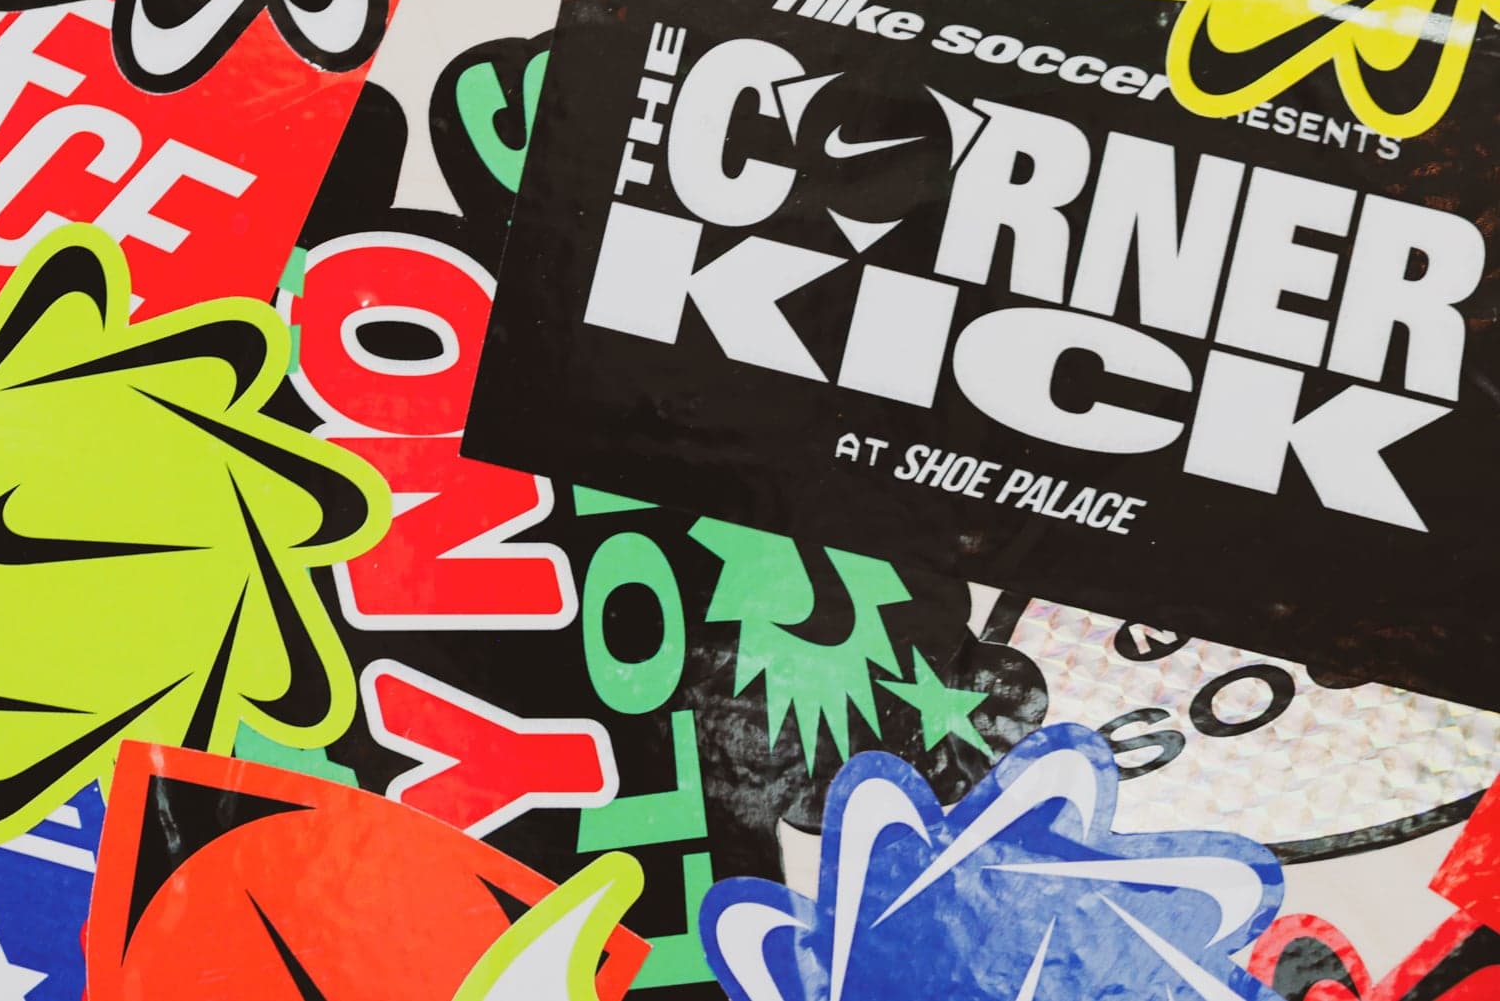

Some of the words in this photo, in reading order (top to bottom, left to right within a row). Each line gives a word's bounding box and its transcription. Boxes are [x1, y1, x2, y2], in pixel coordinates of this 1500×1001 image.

[613, 22, 688, 195] THE
[931, 23, 1174, 102] soccer
[1222, 102, 1403, 160] ESENTS
[584, 203, 1455, 532] KICK
[835, 432, 889, 466] AT
[894, 445, 1002, 499] SHOE
[996, 469, 1147, 535] PALACE
